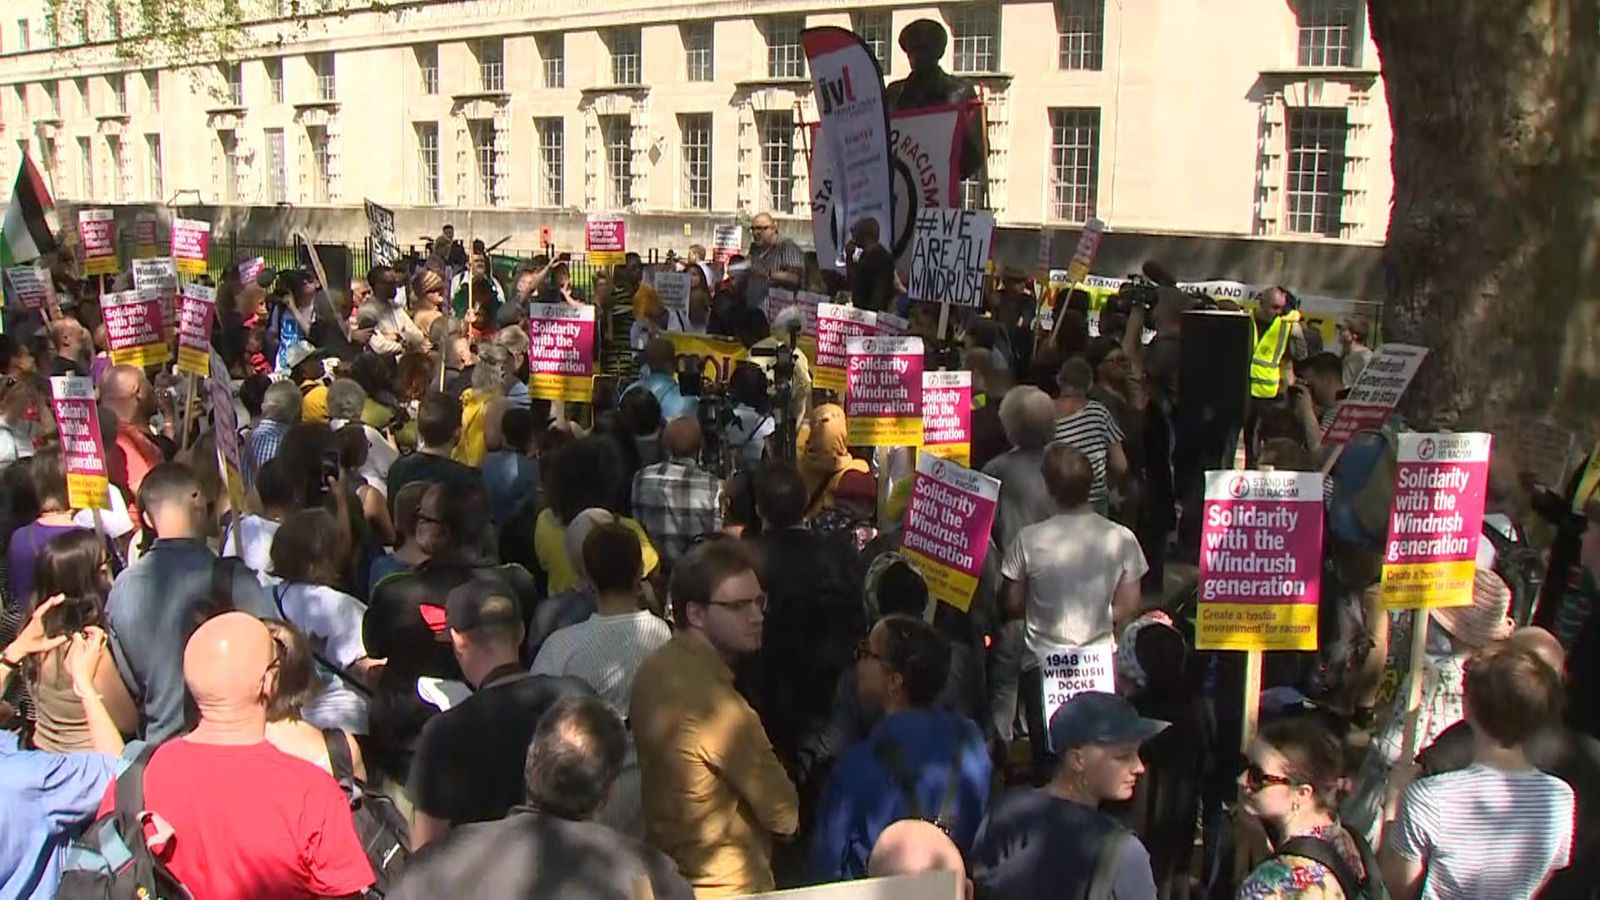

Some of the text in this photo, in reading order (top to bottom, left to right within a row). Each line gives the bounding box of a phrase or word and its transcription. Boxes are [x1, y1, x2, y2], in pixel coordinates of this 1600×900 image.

[818, 65, 856, 115] jvl
[811, 179, 833, 214] STA
[900, 136, 940, 208] RACISM
[911, 237, 985, 272] ARE ALL
[911, 266, 985, 307] WINDRUSH
[1214, 286, 1241, 297] AND
[105, 303, 148, 319] Solidarity
[106, 315, 144, 329] with the
[532, 320, 581, 338] Solidarity
[819, 319, 864, 337] Solidarity
[109, 323, 153, 339] Windrush
[819, 332, 839, 344] with
[111, 333, 160, 350] generation
[532, 334, 573, 347] with the
[532, 346, 580, 360] Windrush
[532, 360, 586, 374] generation
[850, 356, 909, 374] Solidarity
[850, 371, 876, 385] with
[880, 371, 900, 385] the
[851, 385, 908, 399] Windrush
[57, 401, 90, 422] Solidarity
[850, 401, 915, 415] generation
[941, 402, 955, 415] the
[78, 420, 89, 437] the
[925, 428, 965, 442] eneration
[1252, 478, 1295, 488] STAND UP
[1398, 467, 1470, 494] Solidarity
[916, 478, 977, 516] Solidarity
[1253, 488, 1299, 498] TO RACISM
[1396, 490, 1457, 511] with the
[913, 497, 963, 529] with the
[1208, 504, 1299, 532] Solidarity
[910, 510, 969, 549] Windrush
[1393, 511, 1463, 535] Windrush
[1206, 529, 1285, 551] with the
[1387, 535, 1469, 561] generation
[904, 531, 973, 570] generation
[1206, 550, 1296, 573] Windrush
[1203, 575, 1306, 600] generation
[1203, 609, 1234, 620] Create
[1266, 623, 1278, 633] for
[1280, 624, 1311, 634] racism
[1046, 654, 1100, 667] 1948 UK
[1058, 679, 1095, 690] DOCKS
